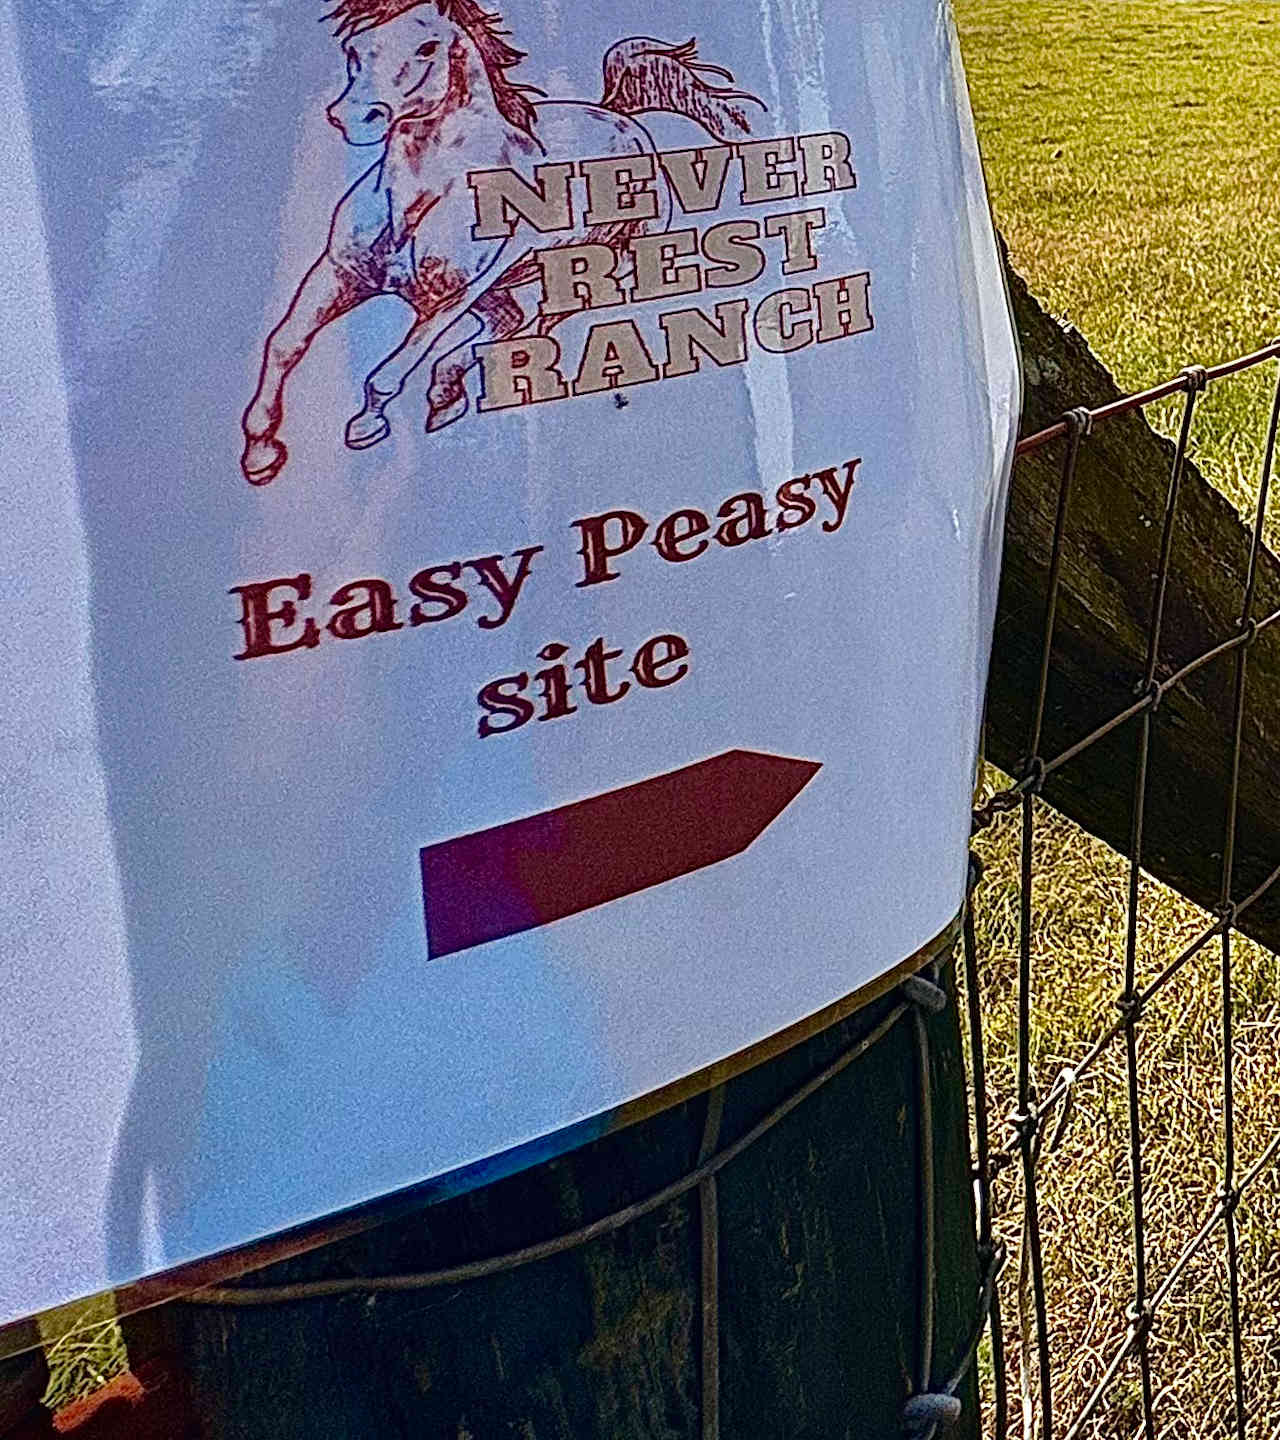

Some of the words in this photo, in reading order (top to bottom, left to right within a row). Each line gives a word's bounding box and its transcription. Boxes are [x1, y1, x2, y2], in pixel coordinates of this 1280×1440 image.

[467, 131, 857, 241] NEVER
[533, 207, 826, 317] REST
[472, 272, 874, 413] RANCH
[228, 545, 545, 661] Easy
[570, 457, 862, 588] Peasy
[476, 633, 690, 740] site
